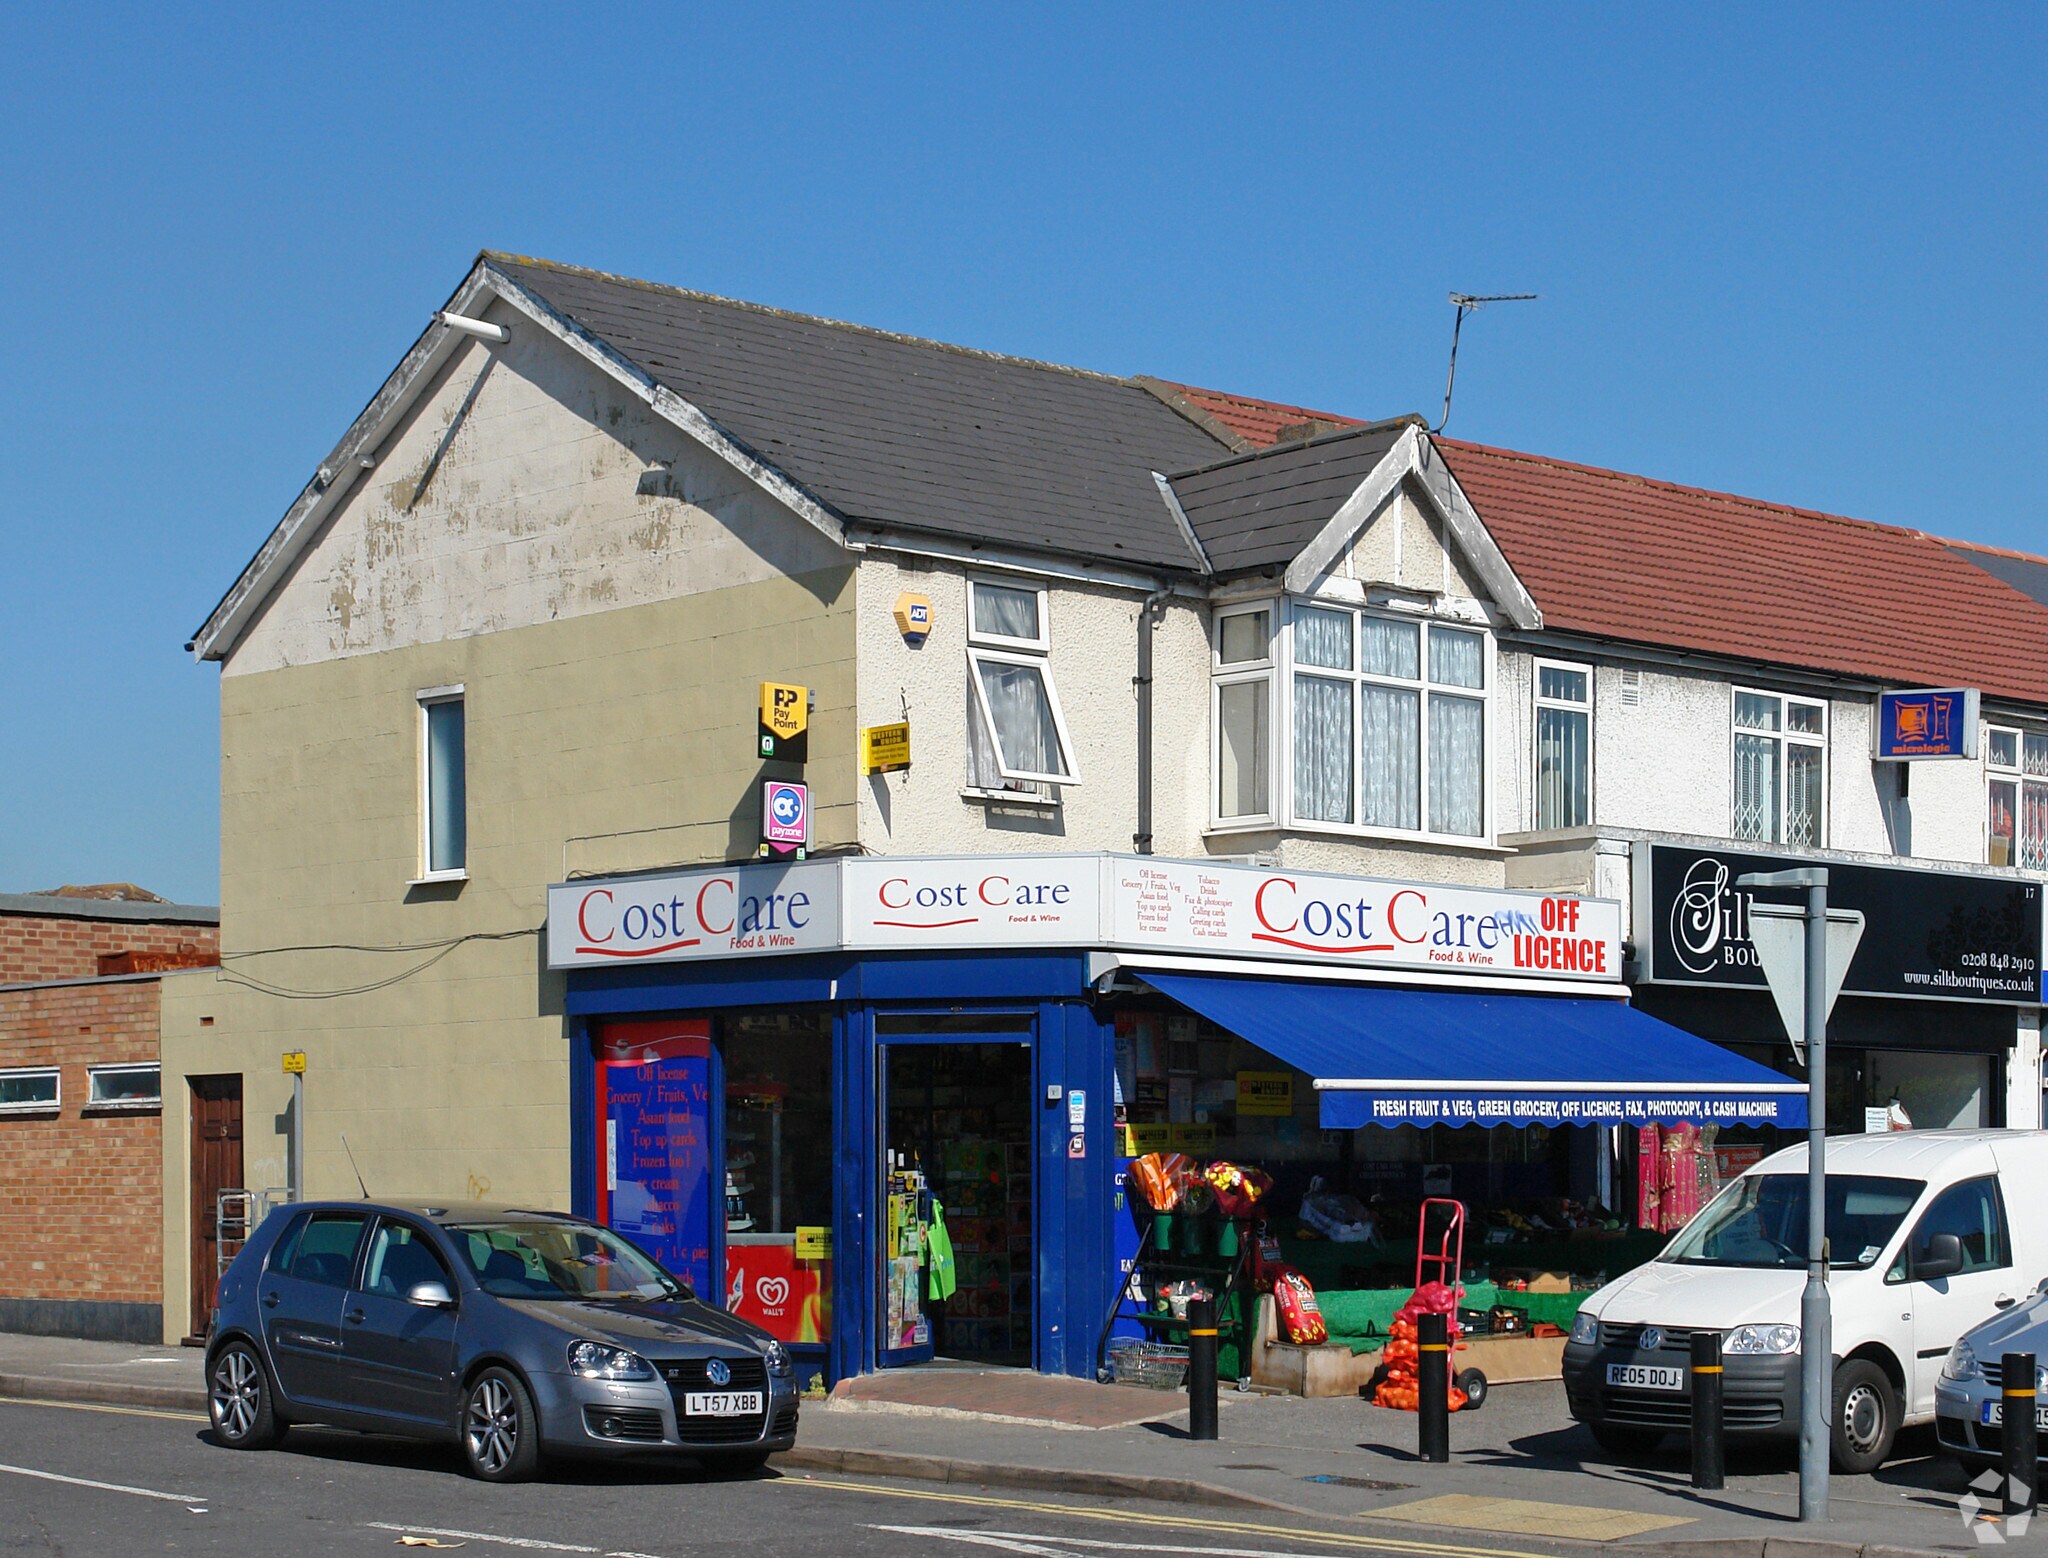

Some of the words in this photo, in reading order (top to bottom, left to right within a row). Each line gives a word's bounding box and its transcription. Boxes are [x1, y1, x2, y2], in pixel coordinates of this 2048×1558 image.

[911, 608, 927, 620] ADT
[774, 708, 790, 720] Pay
[774, 718, 798, 729] Point
[1892, 743, 1950, 754] micrologic
[771, 826, 802, 838] payzone
[1197, 874, 1220, 885] Tobacco
[878, 878, 968, 909] Cost
[978, 875, 1070, 906] Care
[1200, 885, 1217, 895] Drinks
[2025, 887, 2035, 899] 17
[1136, 900, 1148, 912] Top
[1184, 894, 1195, 904] Fax
[578, 889, 685, 943] Cost
[696, 878, 811, 934] Care
[1008, 915, 1028, 923] Food
[1039, 914, 1061, 922] Wine
[1254, 877, 1372, 939] Cost
[1387, 890, 1499, 949] Care
[1541, 897, 1580, 932] OFF
[1193, 927, 1206, 937] Cash
[1207, 928, 1228, 938] machine
[730, 936, 755, 949] Food
[757, 935, 765, 947] &
[768, 934, 795, 946] Wine
[1429, 949, 1454, 963] Food
[1456, 952, 1465, 963] &
[1468, 952, 1494, 965] Wine
[1514, 934, 1606, 973] LICENCE
[1961, 952, 1988, 967] 0208
[1990, 952, 2009, 971] 848
[2011, 956, 2035, 973] 2910
[1904, 968, 2035, 995] www.silkboutiques.co.uk
[637, 1064, 654, 1081] Off
[657, 1064, 689, 1080] license
[606, 1086, 642, 1107] Grocery
[657, 1084, 689, 1104] Fruits,
[638, 1108, 665, 1125] Asian
[669, 1106, 691, 1123] food
[1373, 1100, 1407, 1116] FRESH
[1409, 1100, 1440, 1116] FRUIT
[1442, 1100, 1451, 1116] &
[1451, 1100, 1476, 1119] VEG,
[1477, 1100, 1511, 1116] GREEN
[1513, 1100, 1560, 1120] GROCERY,
[1561, 1101, 1580, 1117] OFF
[1582, 1101, 1624, 1119] LICENCE,
[1625, 1101, 1646, 1118] FAX,
[1647, 1101, 1703, 1119] PHOTOCOPY,
[1704, 1101, 1711, 1116] &
[1713, 1102, 1736, 1116] CASH
[1738, 1102, 1778, 1117] MACHINE
[631, 1129, 652, 1150] Top
[655, 1135, 668, 1150] up
[670, 1128, 697, 1146] cards
[646, 1194, 680, 1212] obacco
[762, 1308, 784, 1316] WALL'S
[1612, 1366, 1645, 1384] RE05
[1649, 1369, 1677, 1386] DOJ
[692, 1395, 729, 1412] LT57
[733, 1395, 757, 1411] XBB
